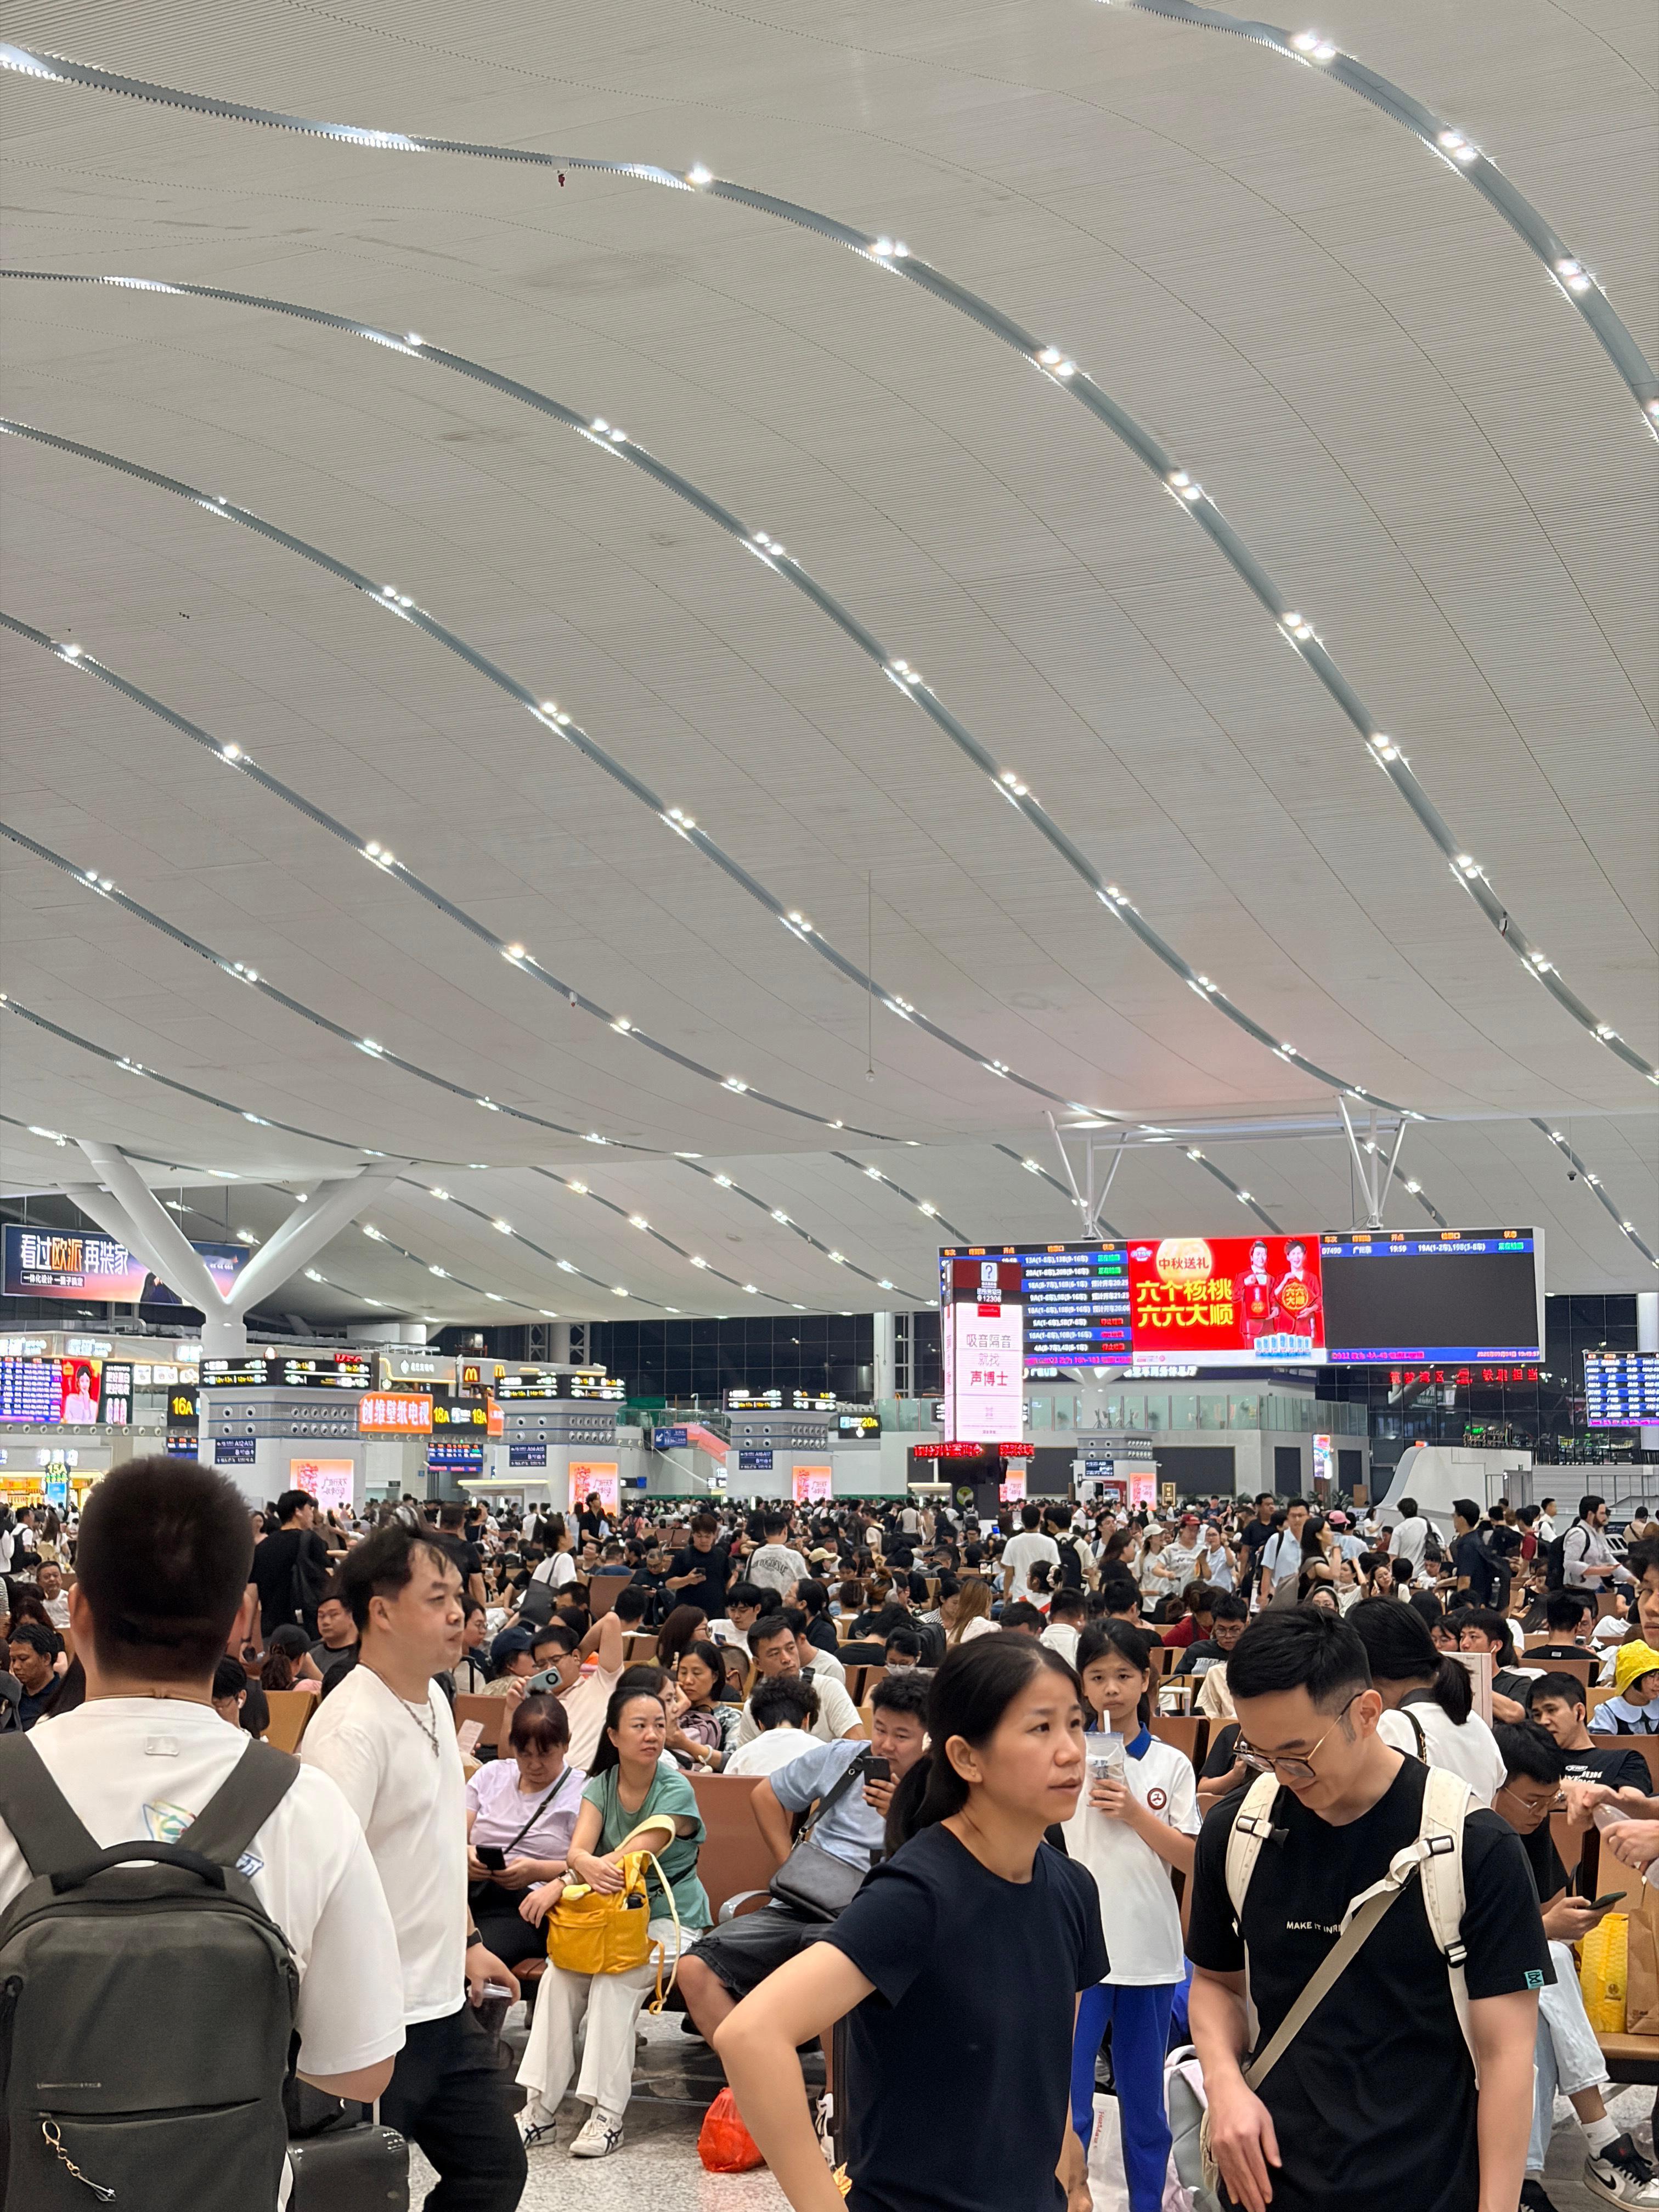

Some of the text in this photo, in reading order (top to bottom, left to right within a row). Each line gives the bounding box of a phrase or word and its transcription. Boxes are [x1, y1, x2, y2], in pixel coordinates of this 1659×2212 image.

[21, 1234, 128, 1276] 看过欧派 再装家
[1158, 1257, 1209, 1270] 中秋送礼
[1136, 1278, 1232, 1302] 六个核桃
[1137, 1303, 1234, 1327] 六六大顺
[967, 1334, 1011, 1348] 吸音隔音
[970, 1370, 1008, 1386] 声博士
[172, 1397, 193, 1415] 16A
[362, 1398, 430, 1426] 创维壁纸电视
[433, 1407, 450, 1423] 18A
[472, 1408, 487, 1424] 19A
[862, 1417, 878, 1427] 20A
[1286, 1921, 1313, 1929] MAKE
